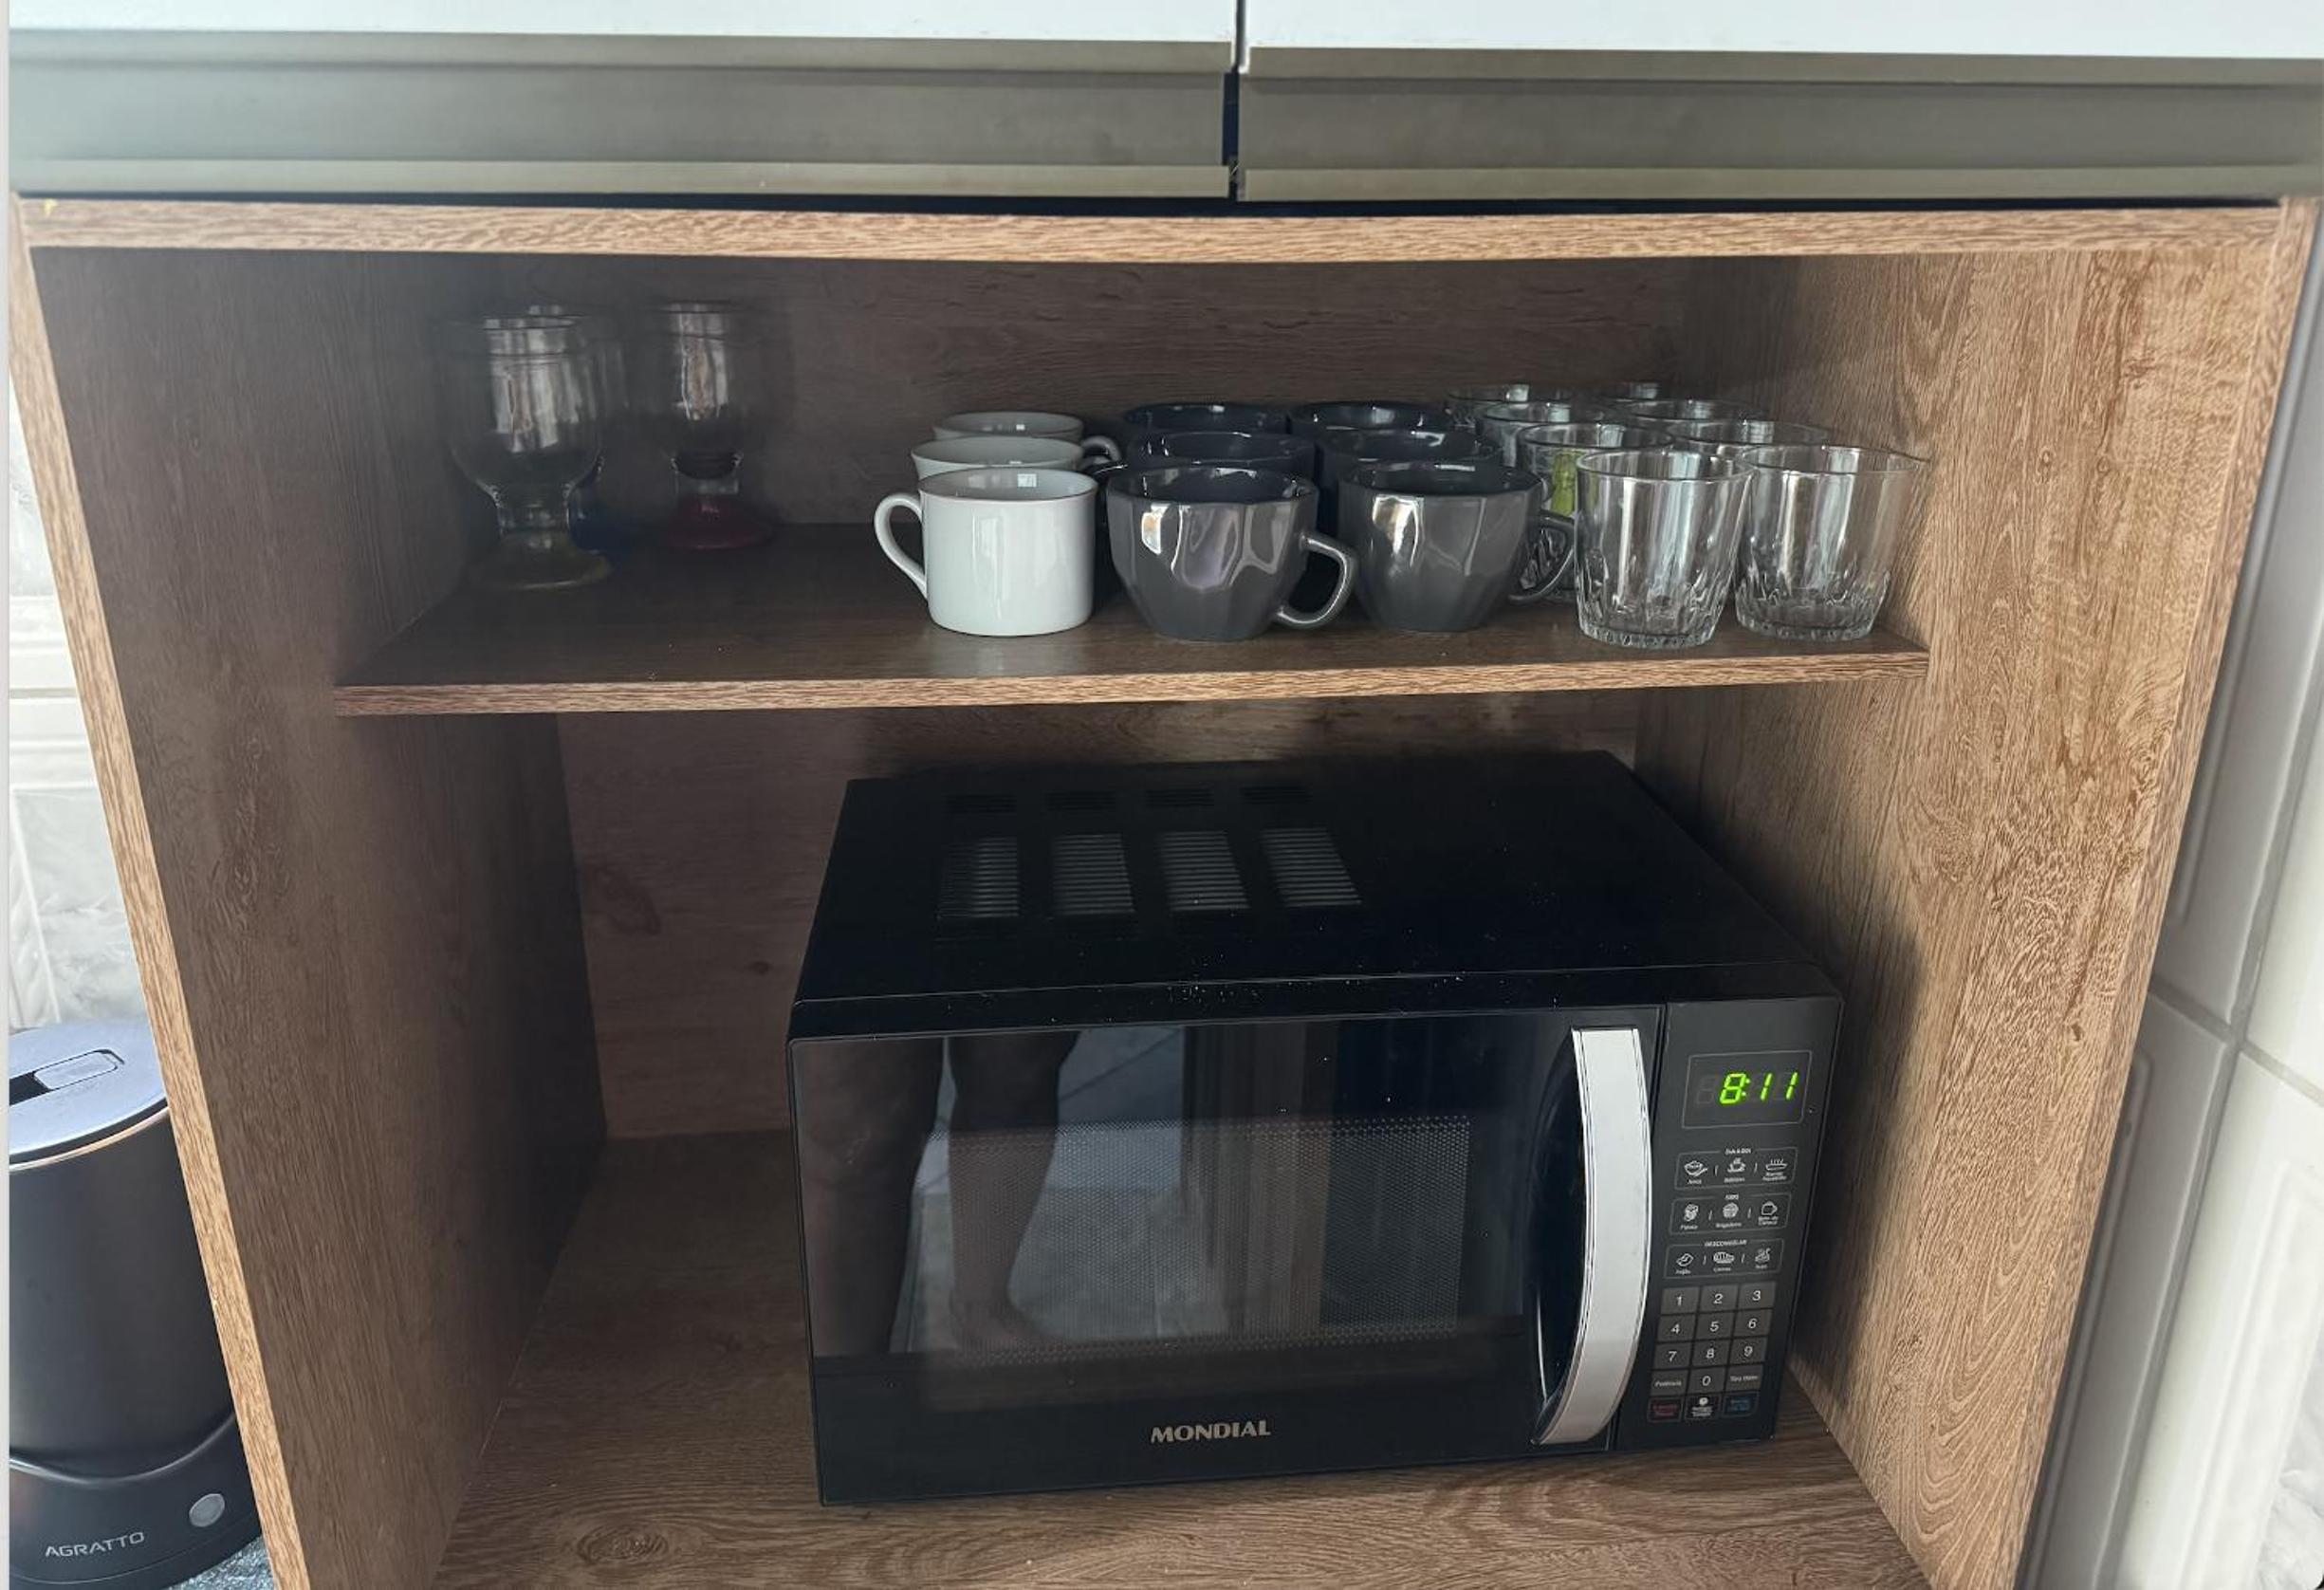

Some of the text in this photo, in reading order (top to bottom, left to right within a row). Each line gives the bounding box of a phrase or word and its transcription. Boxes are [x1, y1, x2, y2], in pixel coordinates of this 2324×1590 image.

[1719, 1071, 1798, 1104] 8:11
[1676, 1290, 1761, 1306] 1 2 3
[1670, 1318, 1758, 1334] 4 5 6
[1668, 1345, 1753, 1362] 7 8 9
[1702, 1376, 1711, 1386] 0
[1151, 1420, 1271, 1443] MONDIAL
[46, 1532, 144, 1557] AGRATTO
